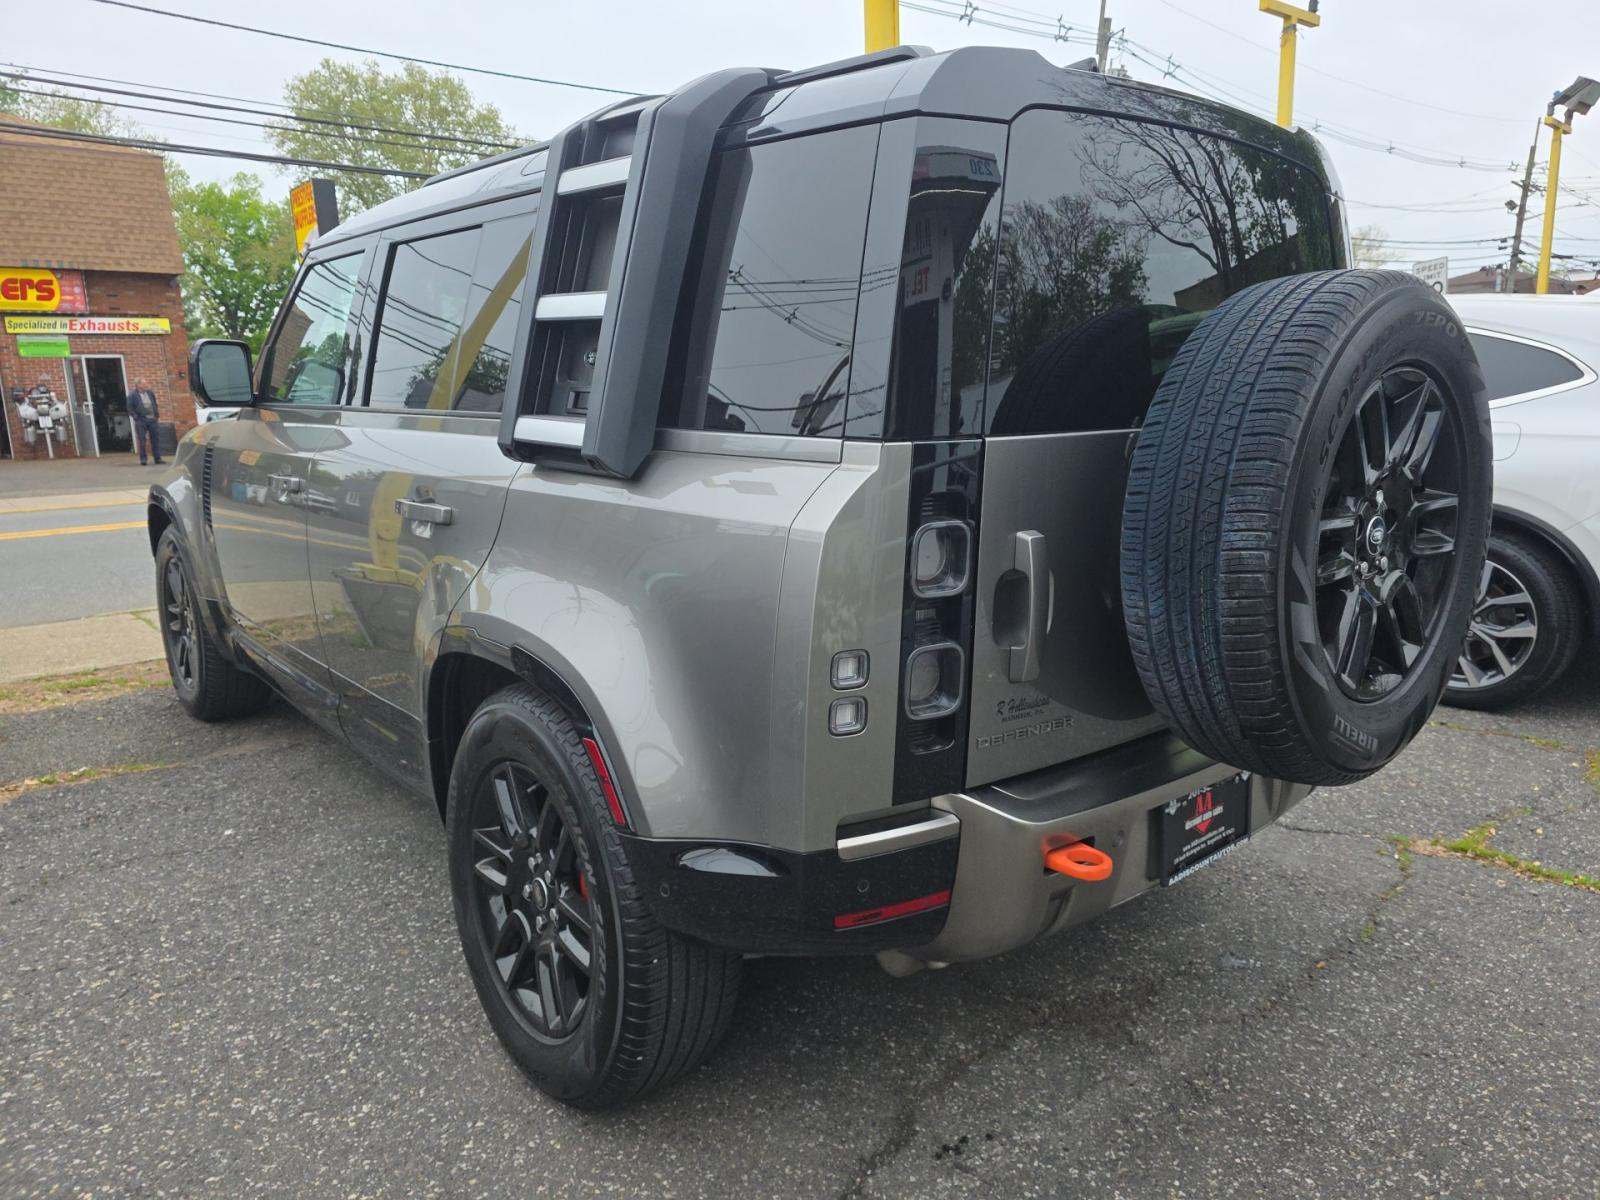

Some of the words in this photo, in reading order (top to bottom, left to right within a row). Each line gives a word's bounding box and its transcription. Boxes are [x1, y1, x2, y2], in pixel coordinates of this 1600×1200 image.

[6, 319, 58, 332] Specialized
[68, 318, 140, 332] Exhausts
[975, 716, 1075, 749] DEFENDER
